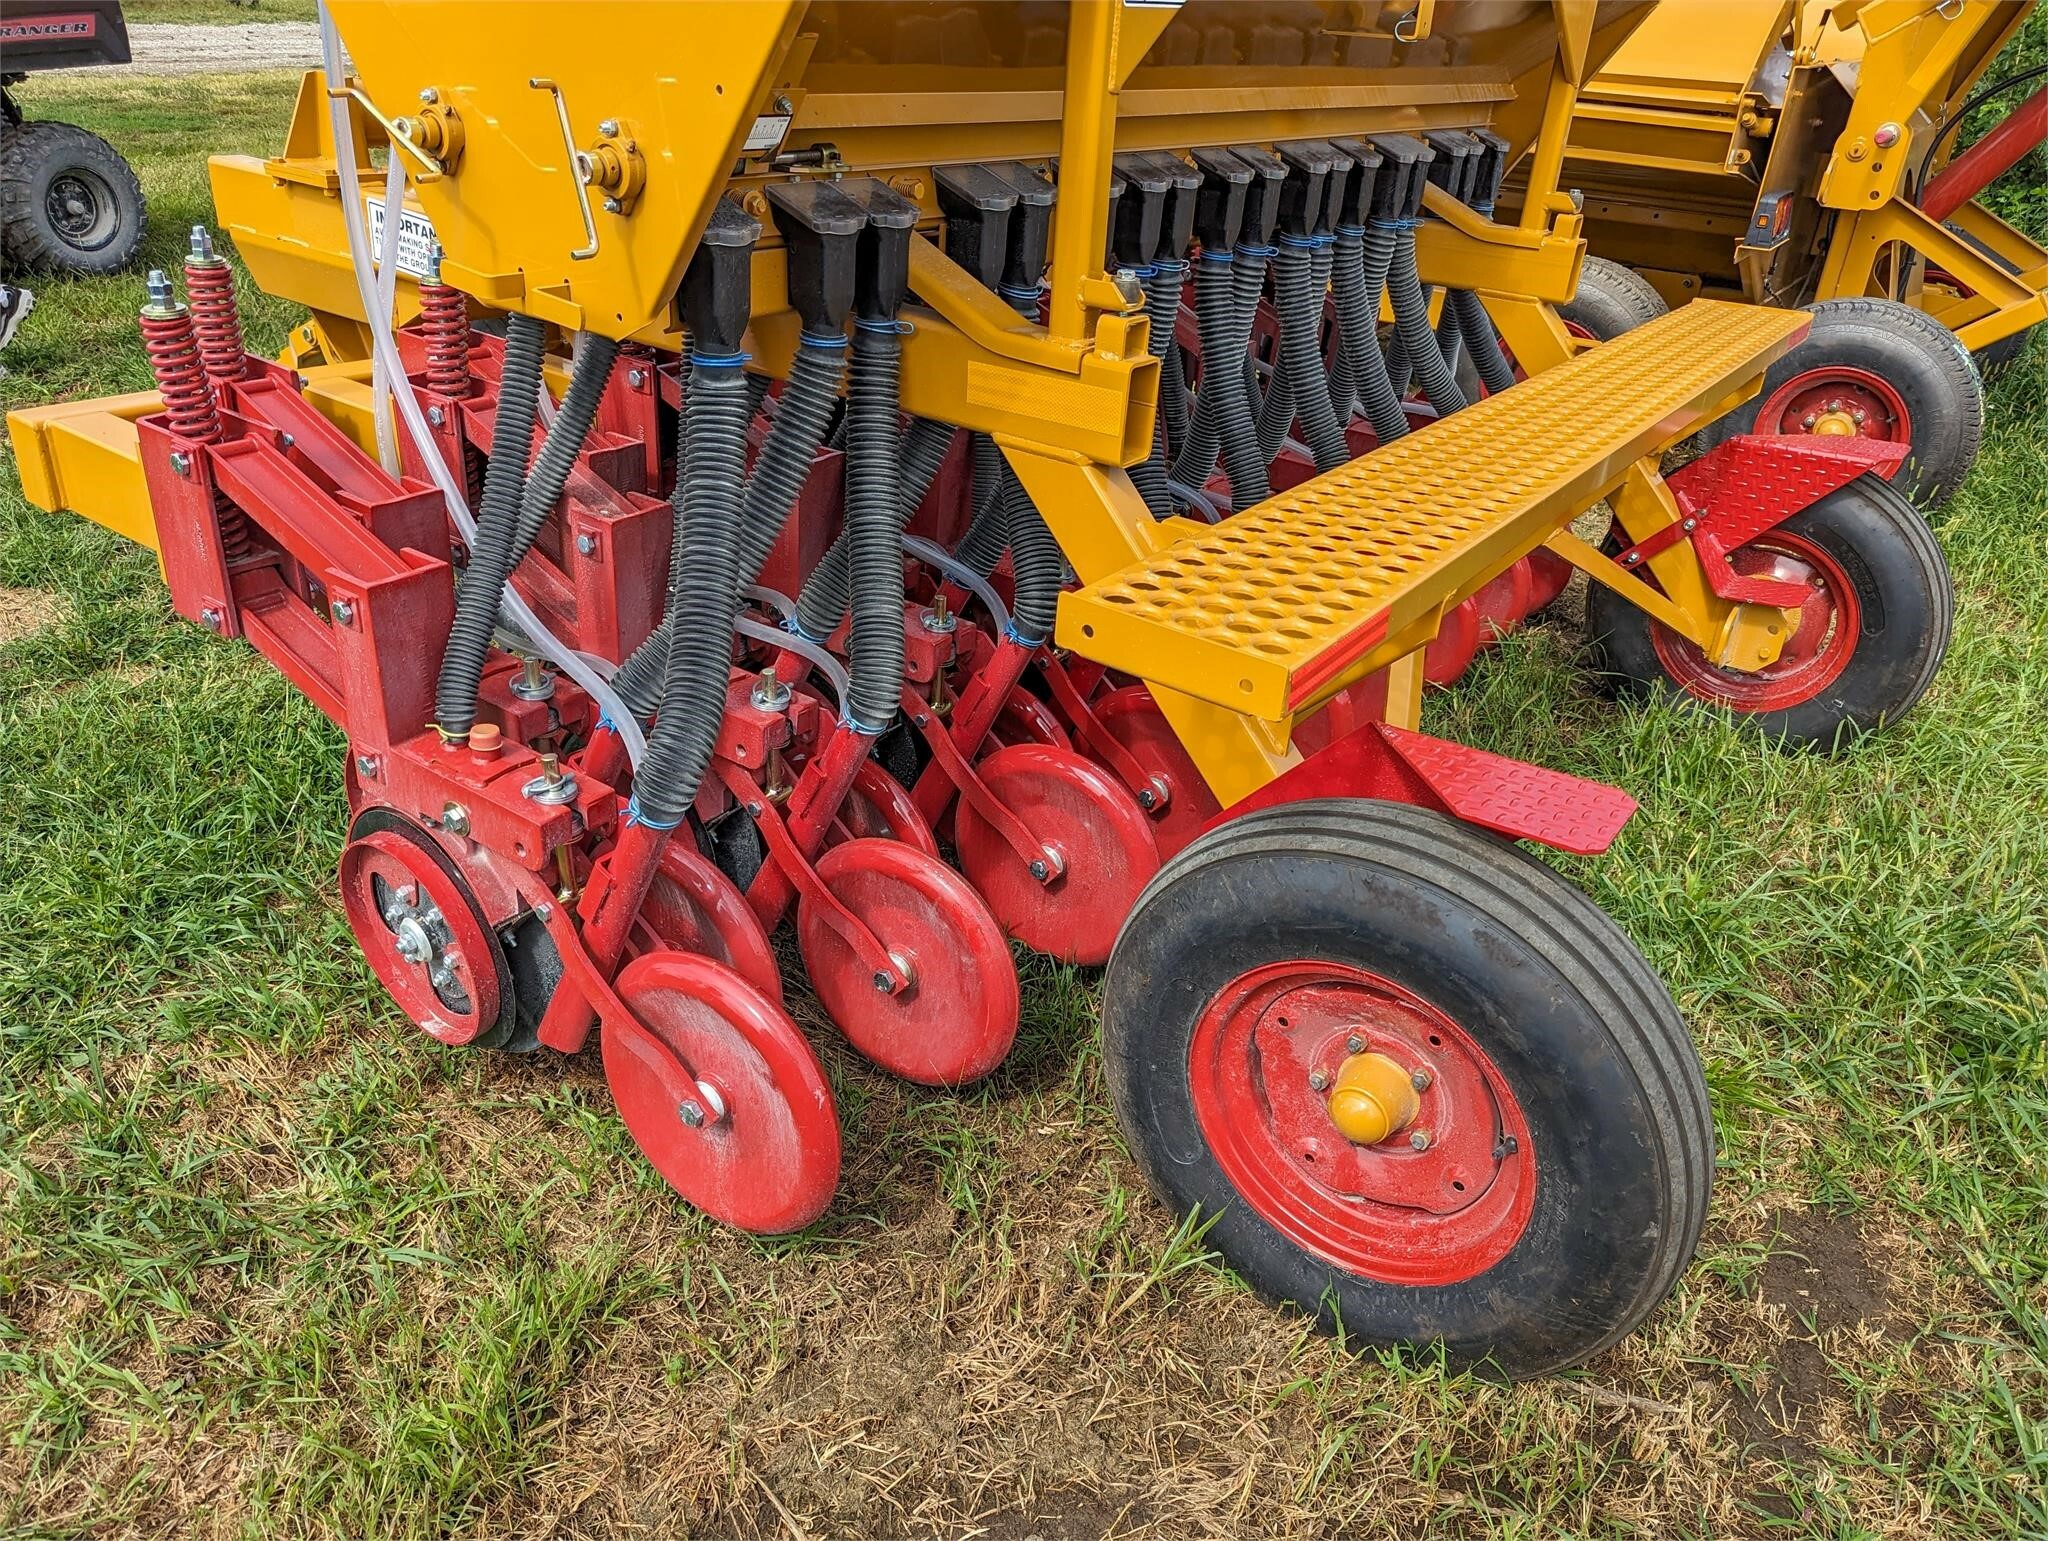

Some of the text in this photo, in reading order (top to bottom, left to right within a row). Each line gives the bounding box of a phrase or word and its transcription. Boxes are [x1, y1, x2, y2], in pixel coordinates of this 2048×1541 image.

[0, 23, 88, 36] RANGER
[376, 210, 436, 239] IORTAN
[411, 258, 429, 271] GROU
